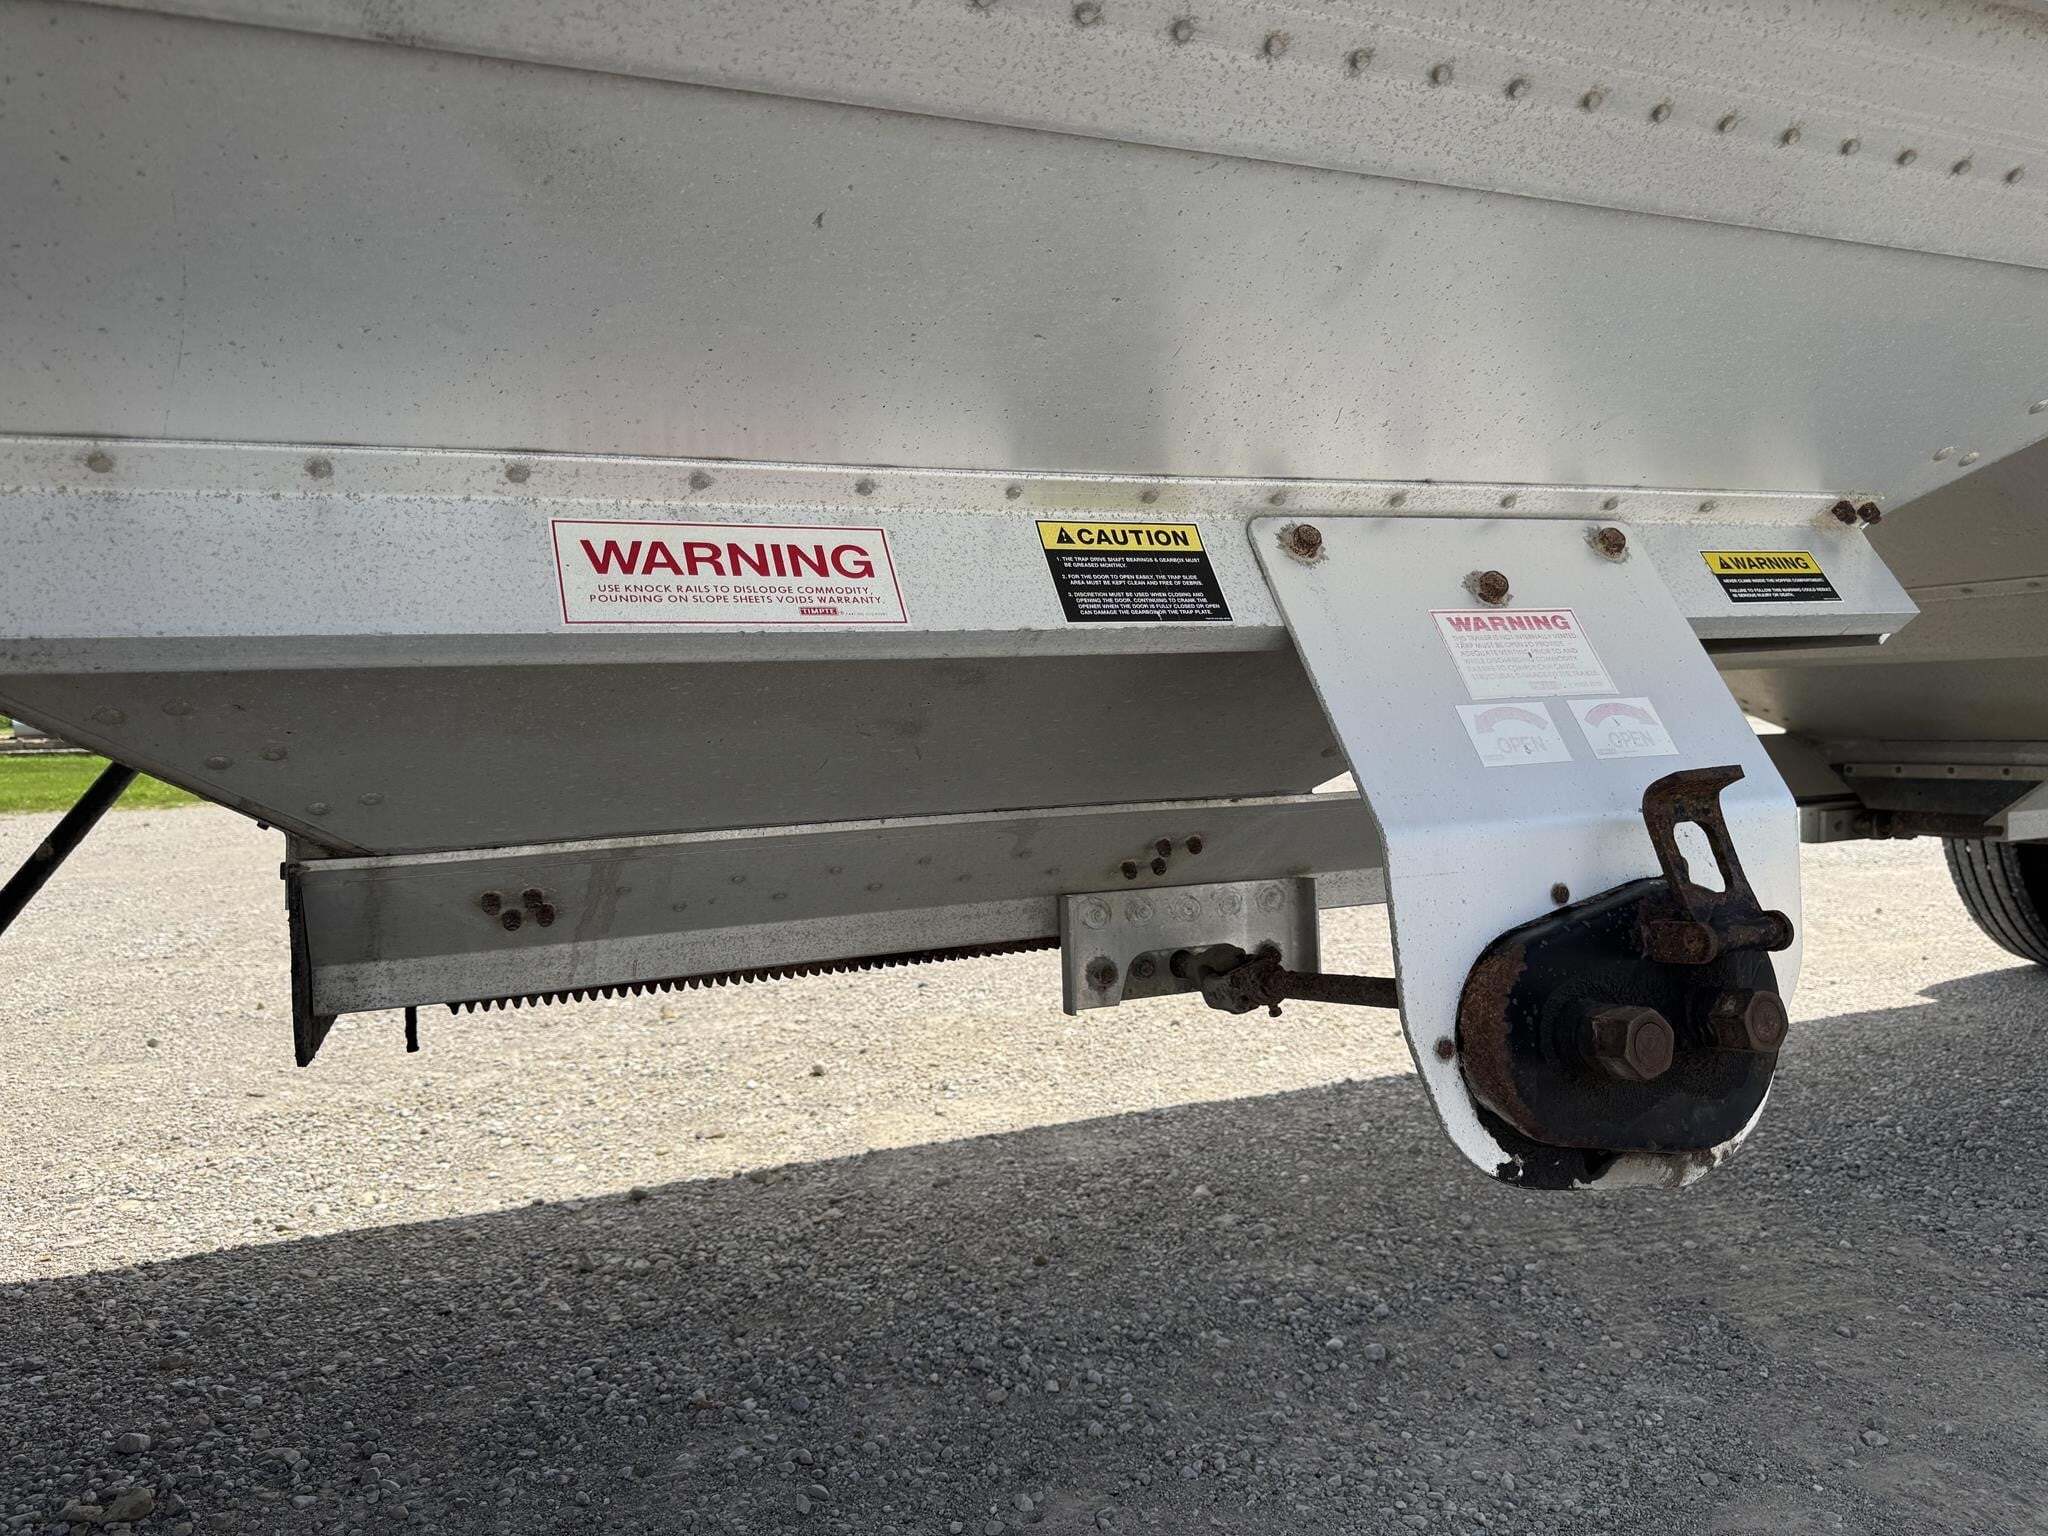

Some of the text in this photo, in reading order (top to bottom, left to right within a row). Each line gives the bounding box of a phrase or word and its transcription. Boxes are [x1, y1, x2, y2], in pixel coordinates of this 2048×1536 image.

[1077, 528, 1190, 546] CAUTION
[580, 540, 875, 578] WARNING
[1729, 557, 1810, 570] WARNING
[598, 584, 620, 592] USE
[625, 584, 672, 592] KNOCK
[713, 585, 730, 593] TO
[734, 586, 793, 594] DISLODGE
[798, 586, 873, 595] COMMODITY,
[590, 594, 662, 603] POUNDING
[668, 594, 688, 603] ON
[693, 595, 729, 603] SLOPE
[733, 595, 773, 603] SHEETS
[776, 596, 813, 604] VOIDS
[1446, 615, 1570, 632] WARNING
[1498, 736, 1546, 753] OPEN
[1608, 730, 1656, 748] OPEN
